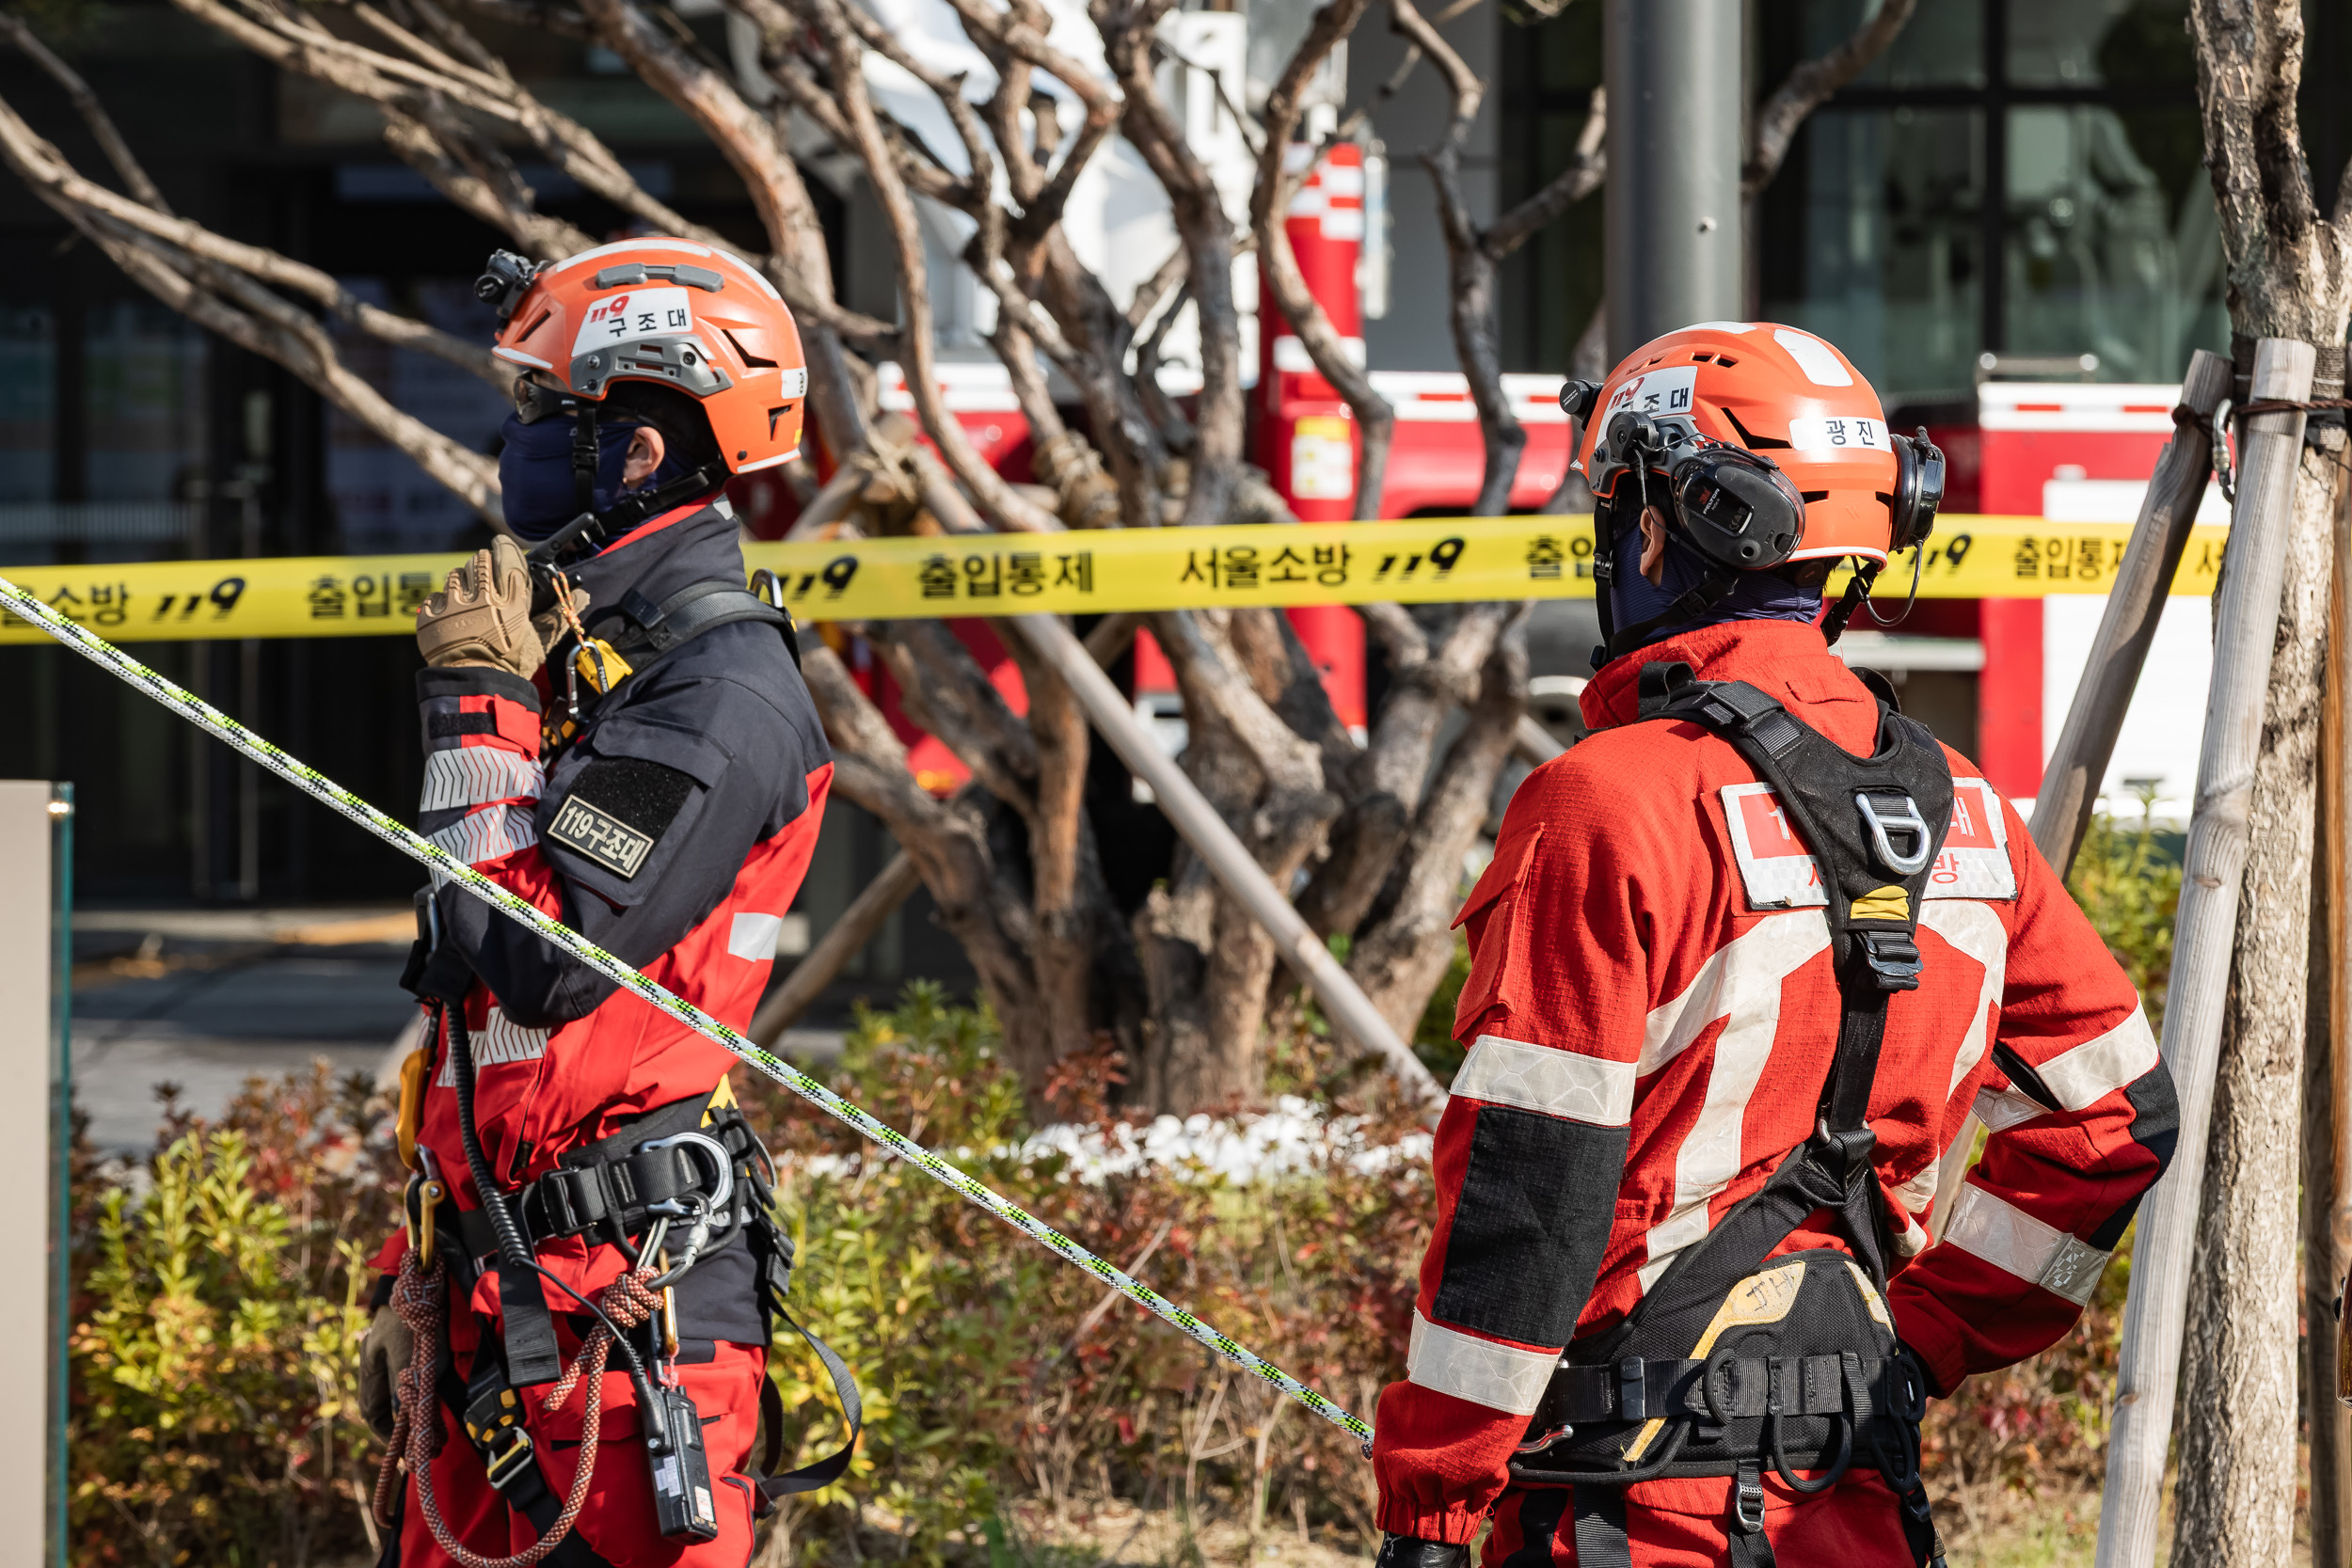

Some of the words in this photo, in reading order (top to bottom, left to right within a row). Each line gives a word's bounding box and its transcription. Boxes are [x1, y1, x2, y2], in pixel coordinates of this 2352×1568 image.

[590, 295, 629, 323] 119
[609, 309, 687, 338] 구조대
[1610, 377, 1645, 411] 119
[1825, 420, 1874, 446] 광진
[151, 577, 246, 623] 119
[308, 573, 432, 619] 출입통
[918, 549, 1094, 598] 출입통제
[1181, 543, 1351, 589] 서울소방
[1373, 536, 1466, 583] 119
[1526, 534, 1595, 579] 출입
[560, 805, 646, 871] 119구조대
